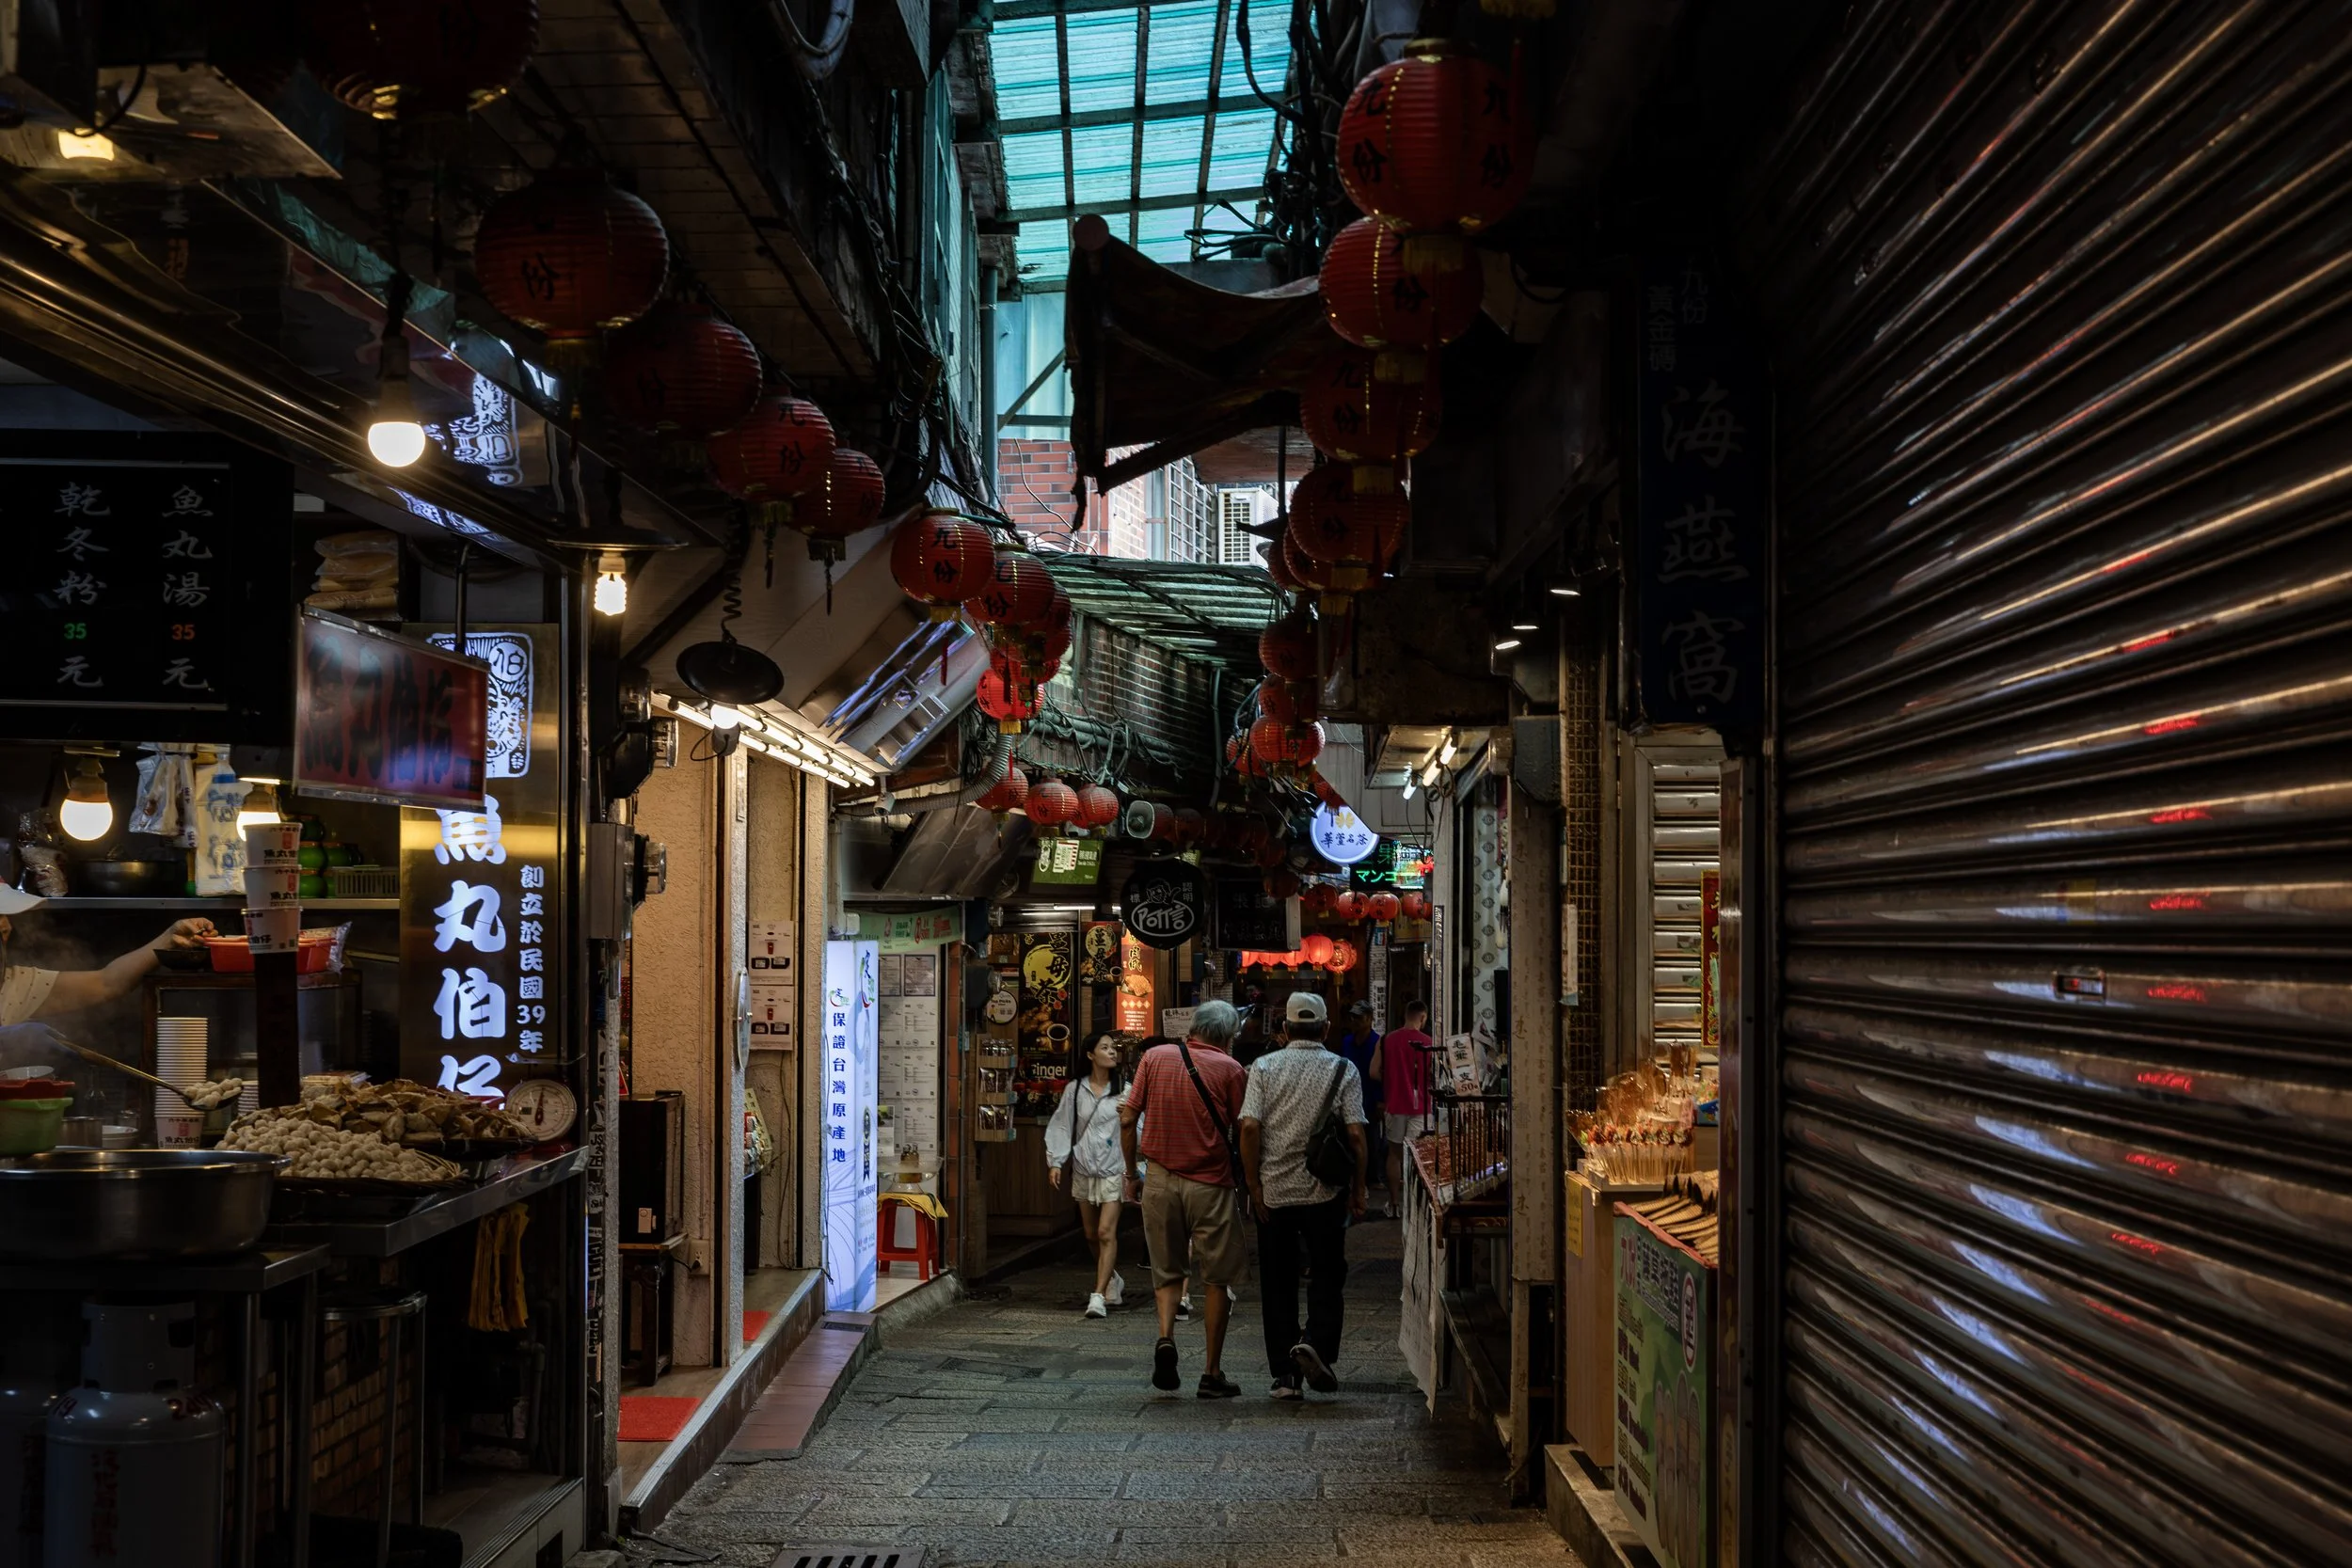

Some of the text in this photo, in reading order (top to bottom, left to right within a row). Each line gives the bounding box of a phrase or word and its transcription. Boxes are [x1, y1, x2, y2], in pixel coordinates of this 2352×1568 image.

[1351, 78, 1388, 187] 九份
[778, 402, 807, 475] 九份
[932, 527, 958, 584] 九份
[1656, 377, 1751, 705] 海燕窩
[516, 864, 547, 1053] 創立於民國39年
[832, 1012, 847, 1163] 保證台灣原產地
[1452, 1039, 1473, 1084] 毛筆一支
